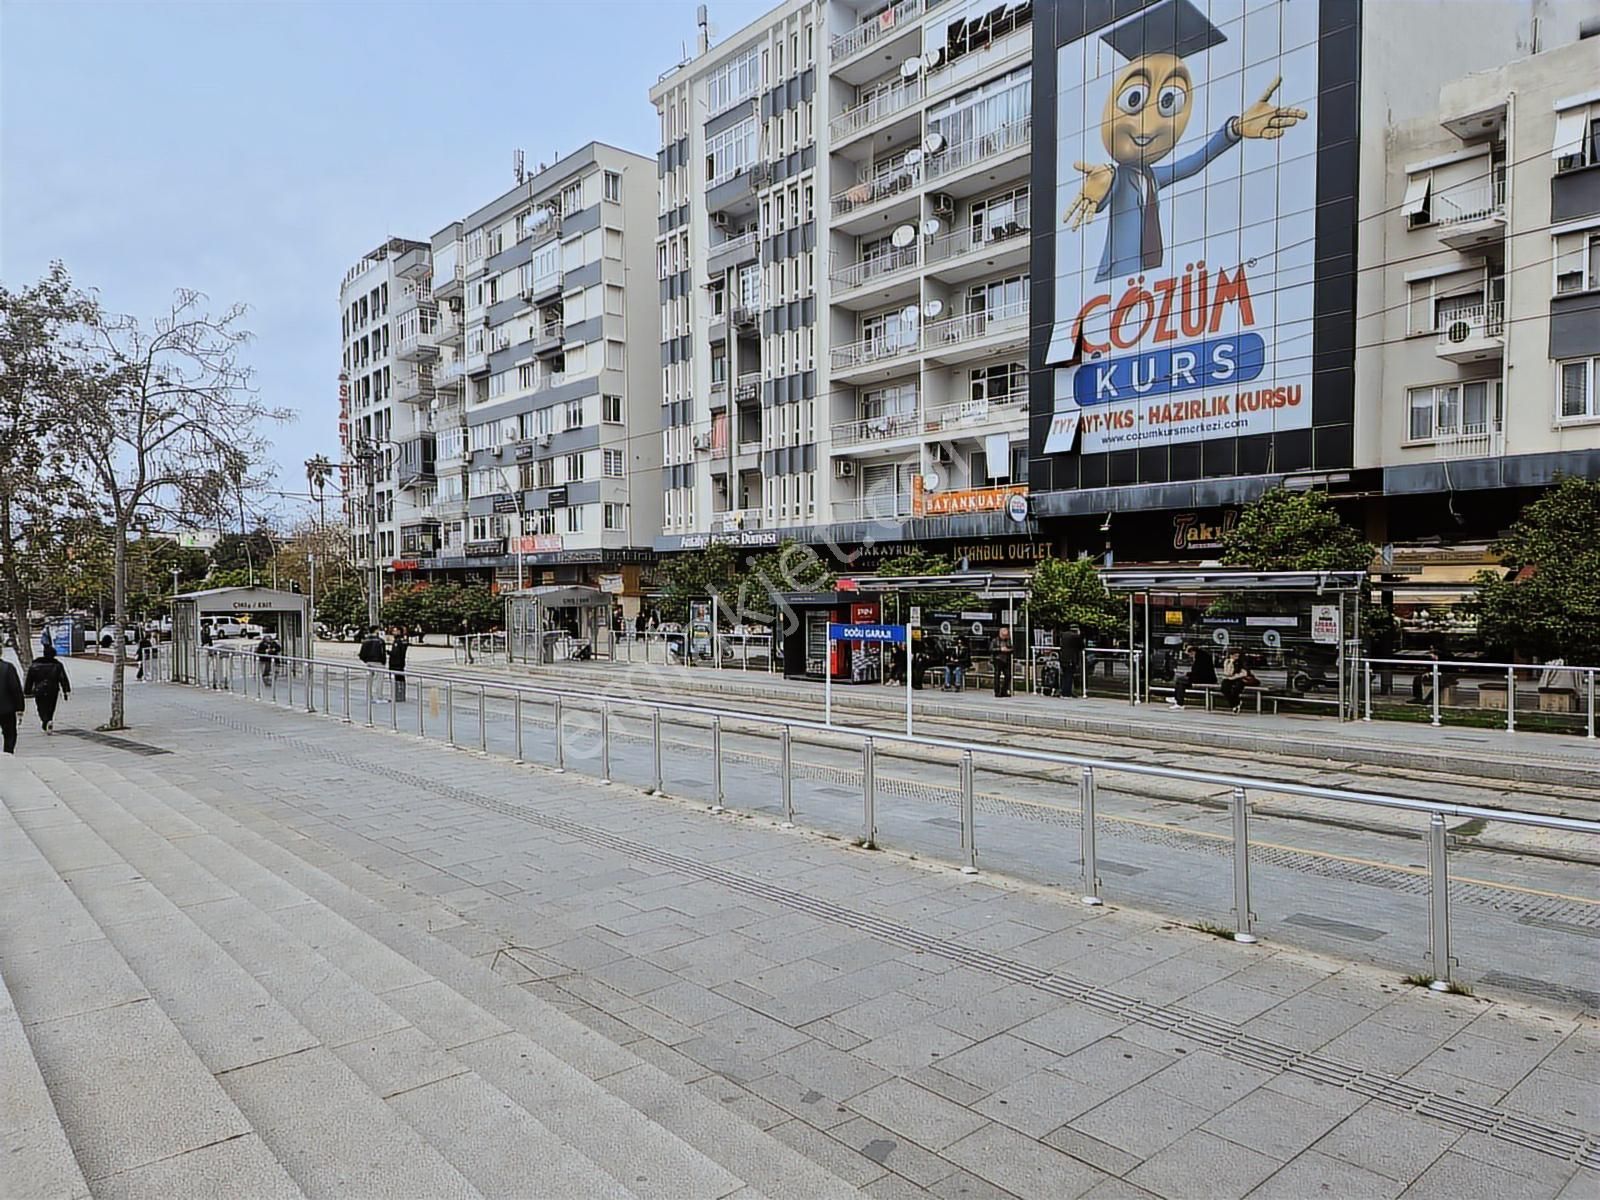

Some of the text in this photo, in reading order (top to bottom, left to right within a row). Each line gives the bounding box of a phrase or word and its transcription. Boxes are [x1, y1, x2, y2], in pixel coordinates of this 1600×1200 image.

[1071, 260, 1255, 359] ÇÖZÜM
[1096, 343, 1237, 399] KURS
[1148, 395, 1231, 425] HAZIRLIK
[1235, 384, 1302, 414] KURSU
[1100, 417, 1248, 445] www.cozumkursmerkezi.com
[1008, 542, 1053, 560] OUTLET
[844, 627, 864, 638] DOĞU
